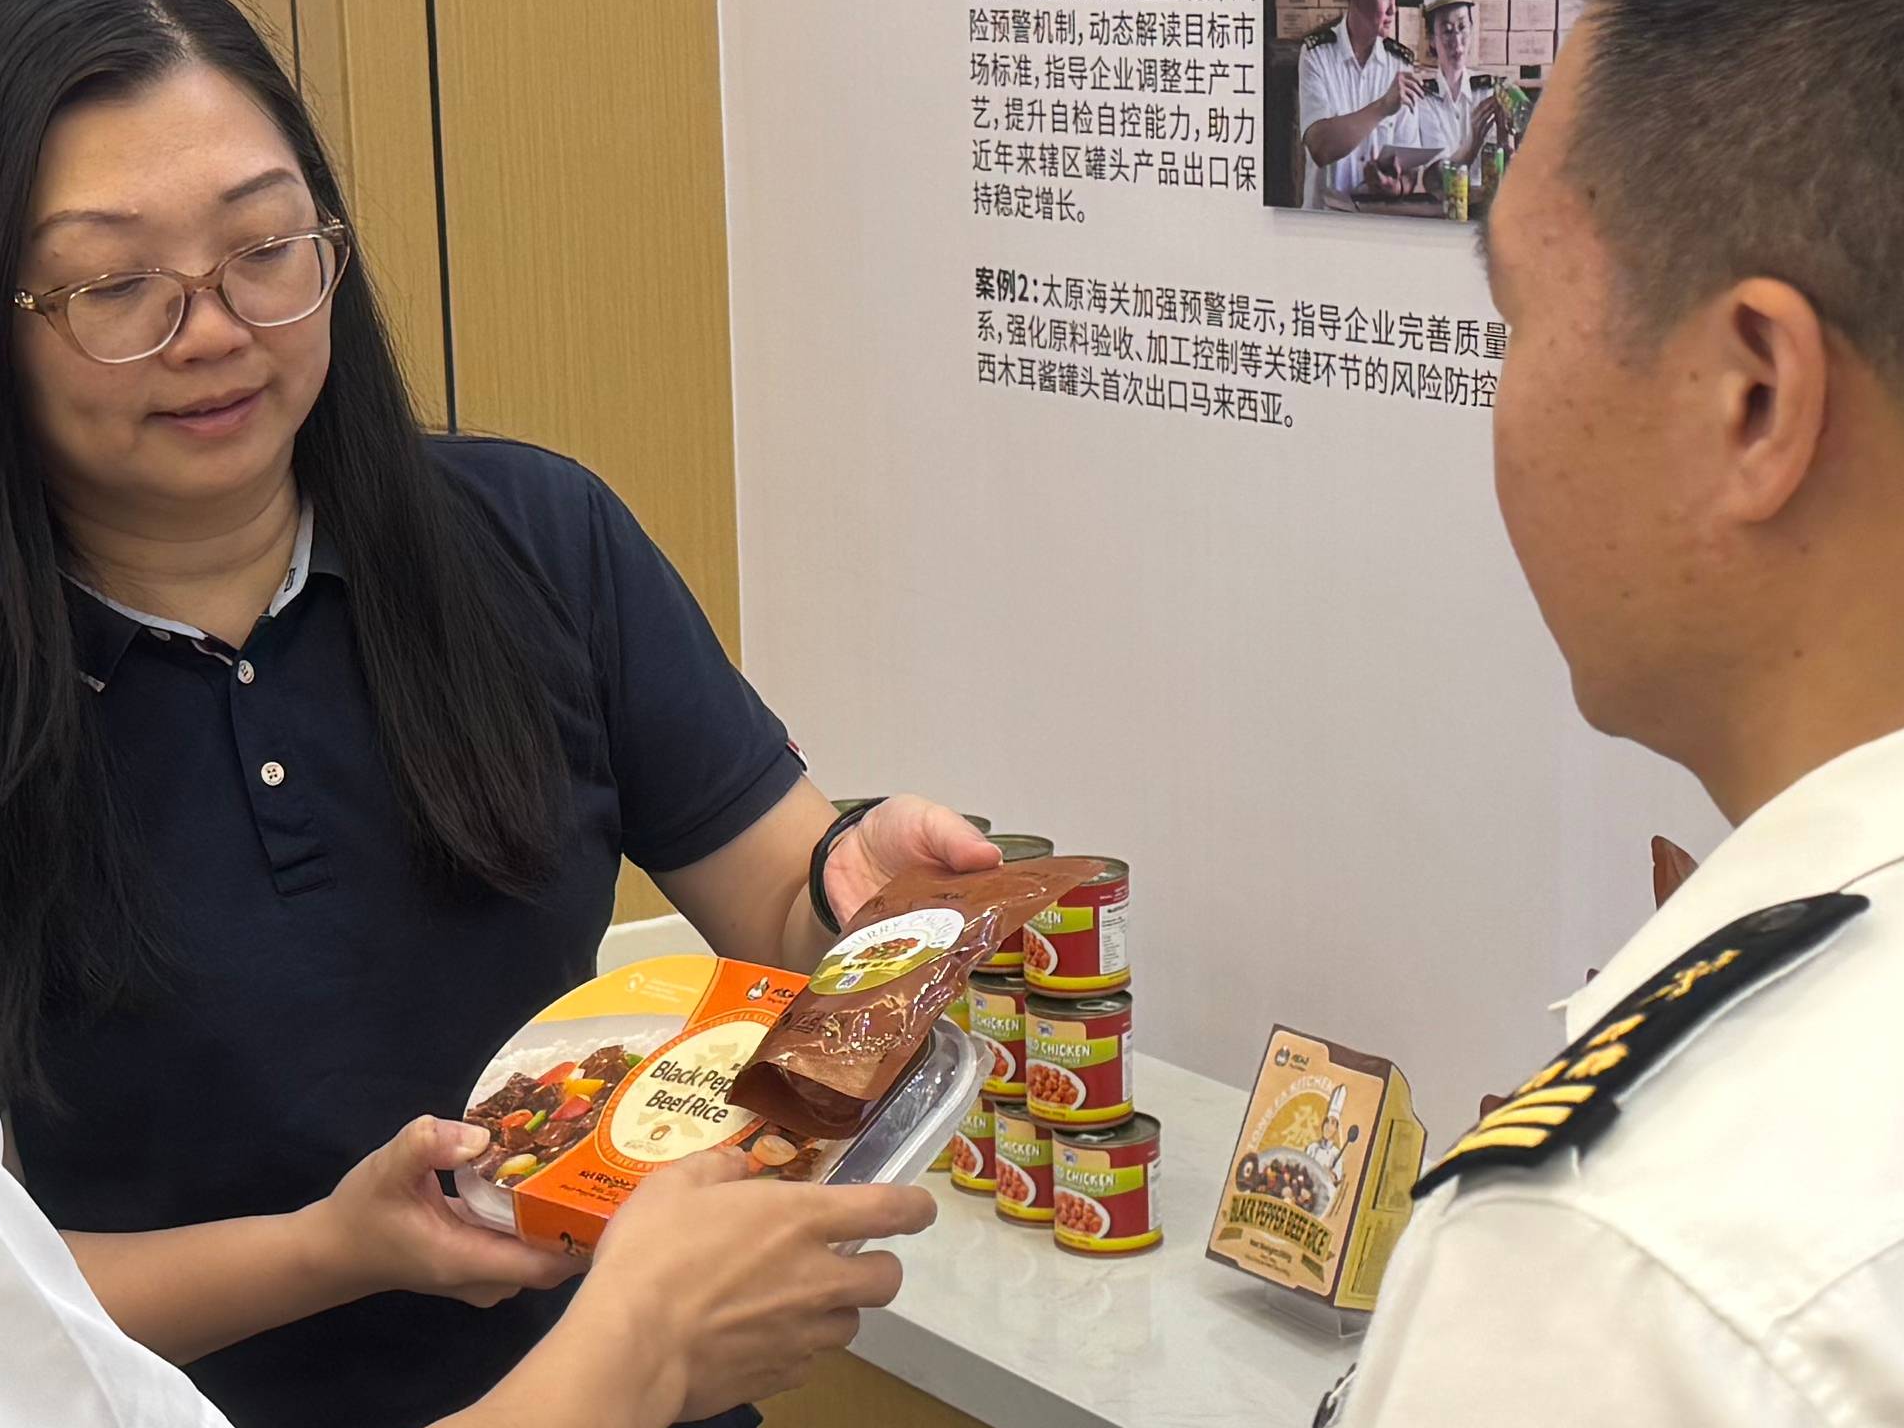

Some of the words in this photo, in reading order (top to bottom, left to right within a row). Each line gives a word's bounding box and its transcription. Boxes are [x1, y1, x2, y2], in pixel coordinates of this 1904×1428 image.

[972, 139, 1258, 192] 近年来辖区罐头产品出口保
[973, 181, 1085, 223] 持稳定增长。
[1041, 1042, 1092, 1058] CHICKEN
[650, 1060, 703, 1086] Black
[698, 1070, 734, 1097] Pep
[646, 1089, 696, 1113] Beef
[685, 1097, 729, 1124] Rice
[1066, 1171, 1116, 1188] CHICKEN
